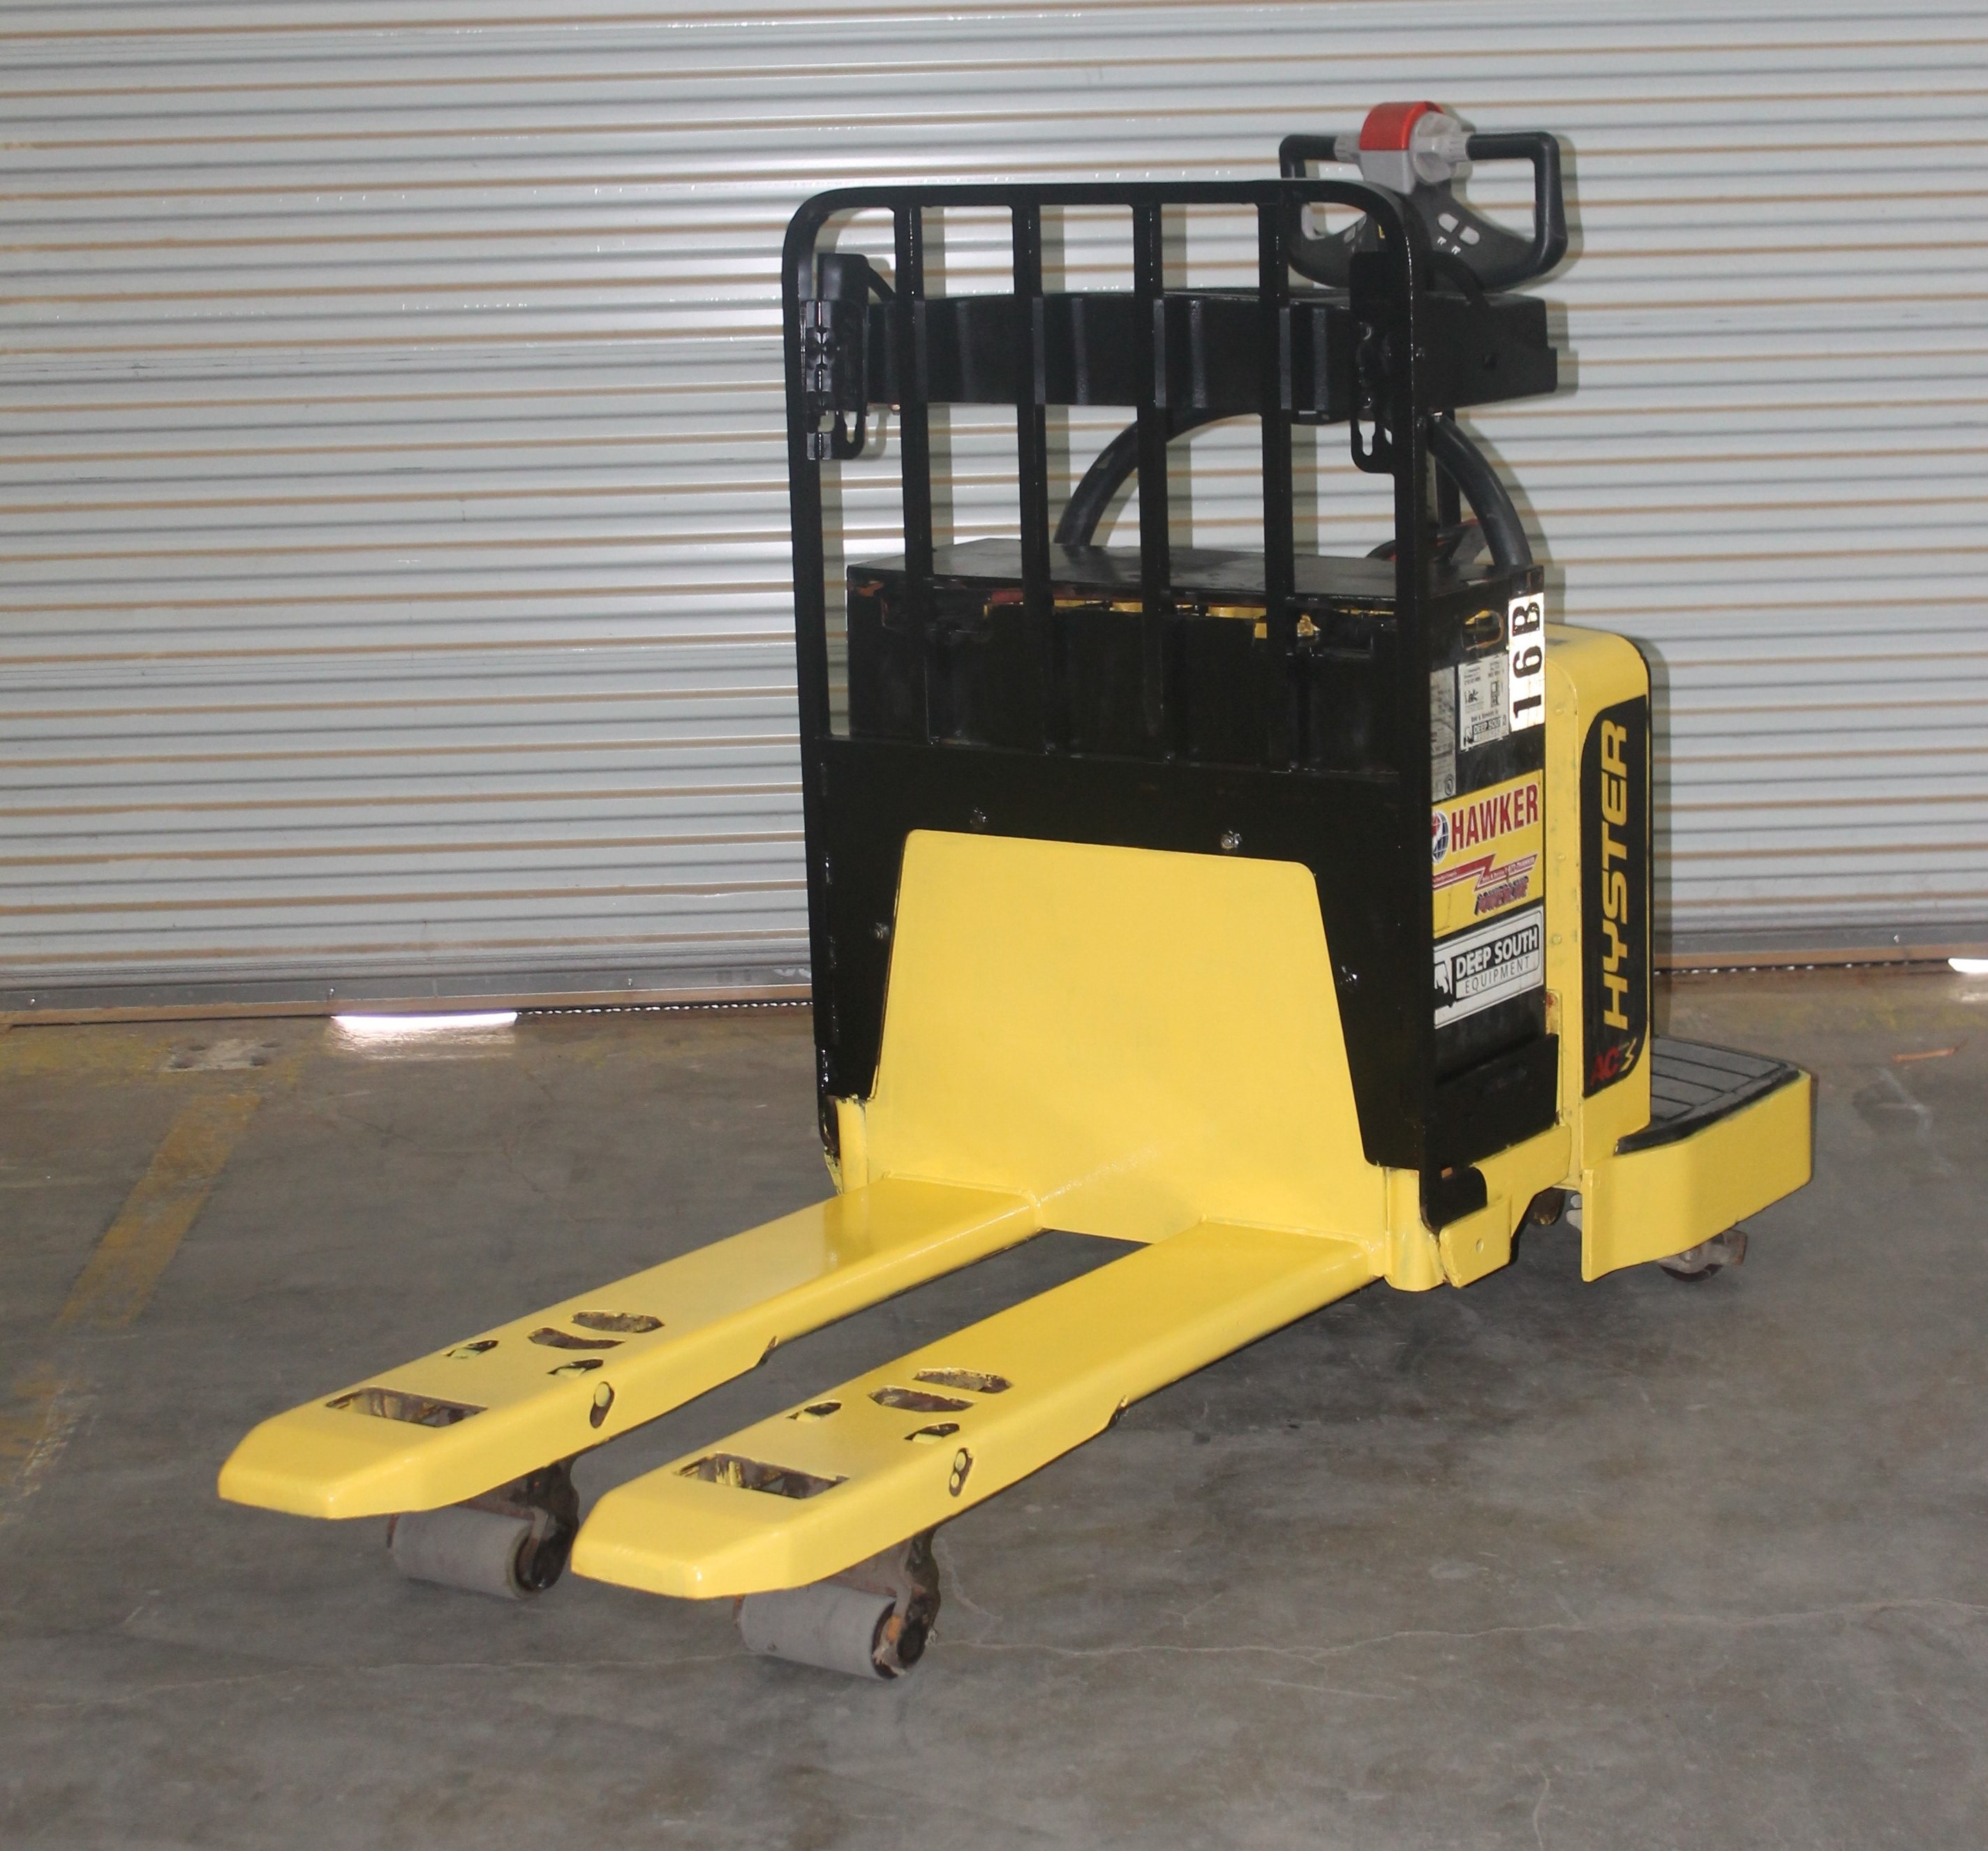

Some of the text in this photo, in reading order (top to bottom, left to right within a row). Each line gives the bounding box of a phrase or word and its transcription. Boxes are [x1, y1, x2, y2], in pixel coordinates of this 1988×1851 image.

[1513, 602, 1542, 718] 16B
[1452, 784, 1538, 853] HAWKER
[1601, 720, 1628, 1030] HYSTER
[1456, 927, 1538, 980] DEEP SOUTH
[1465, 956, 1529, 994] EQUIPMENT
